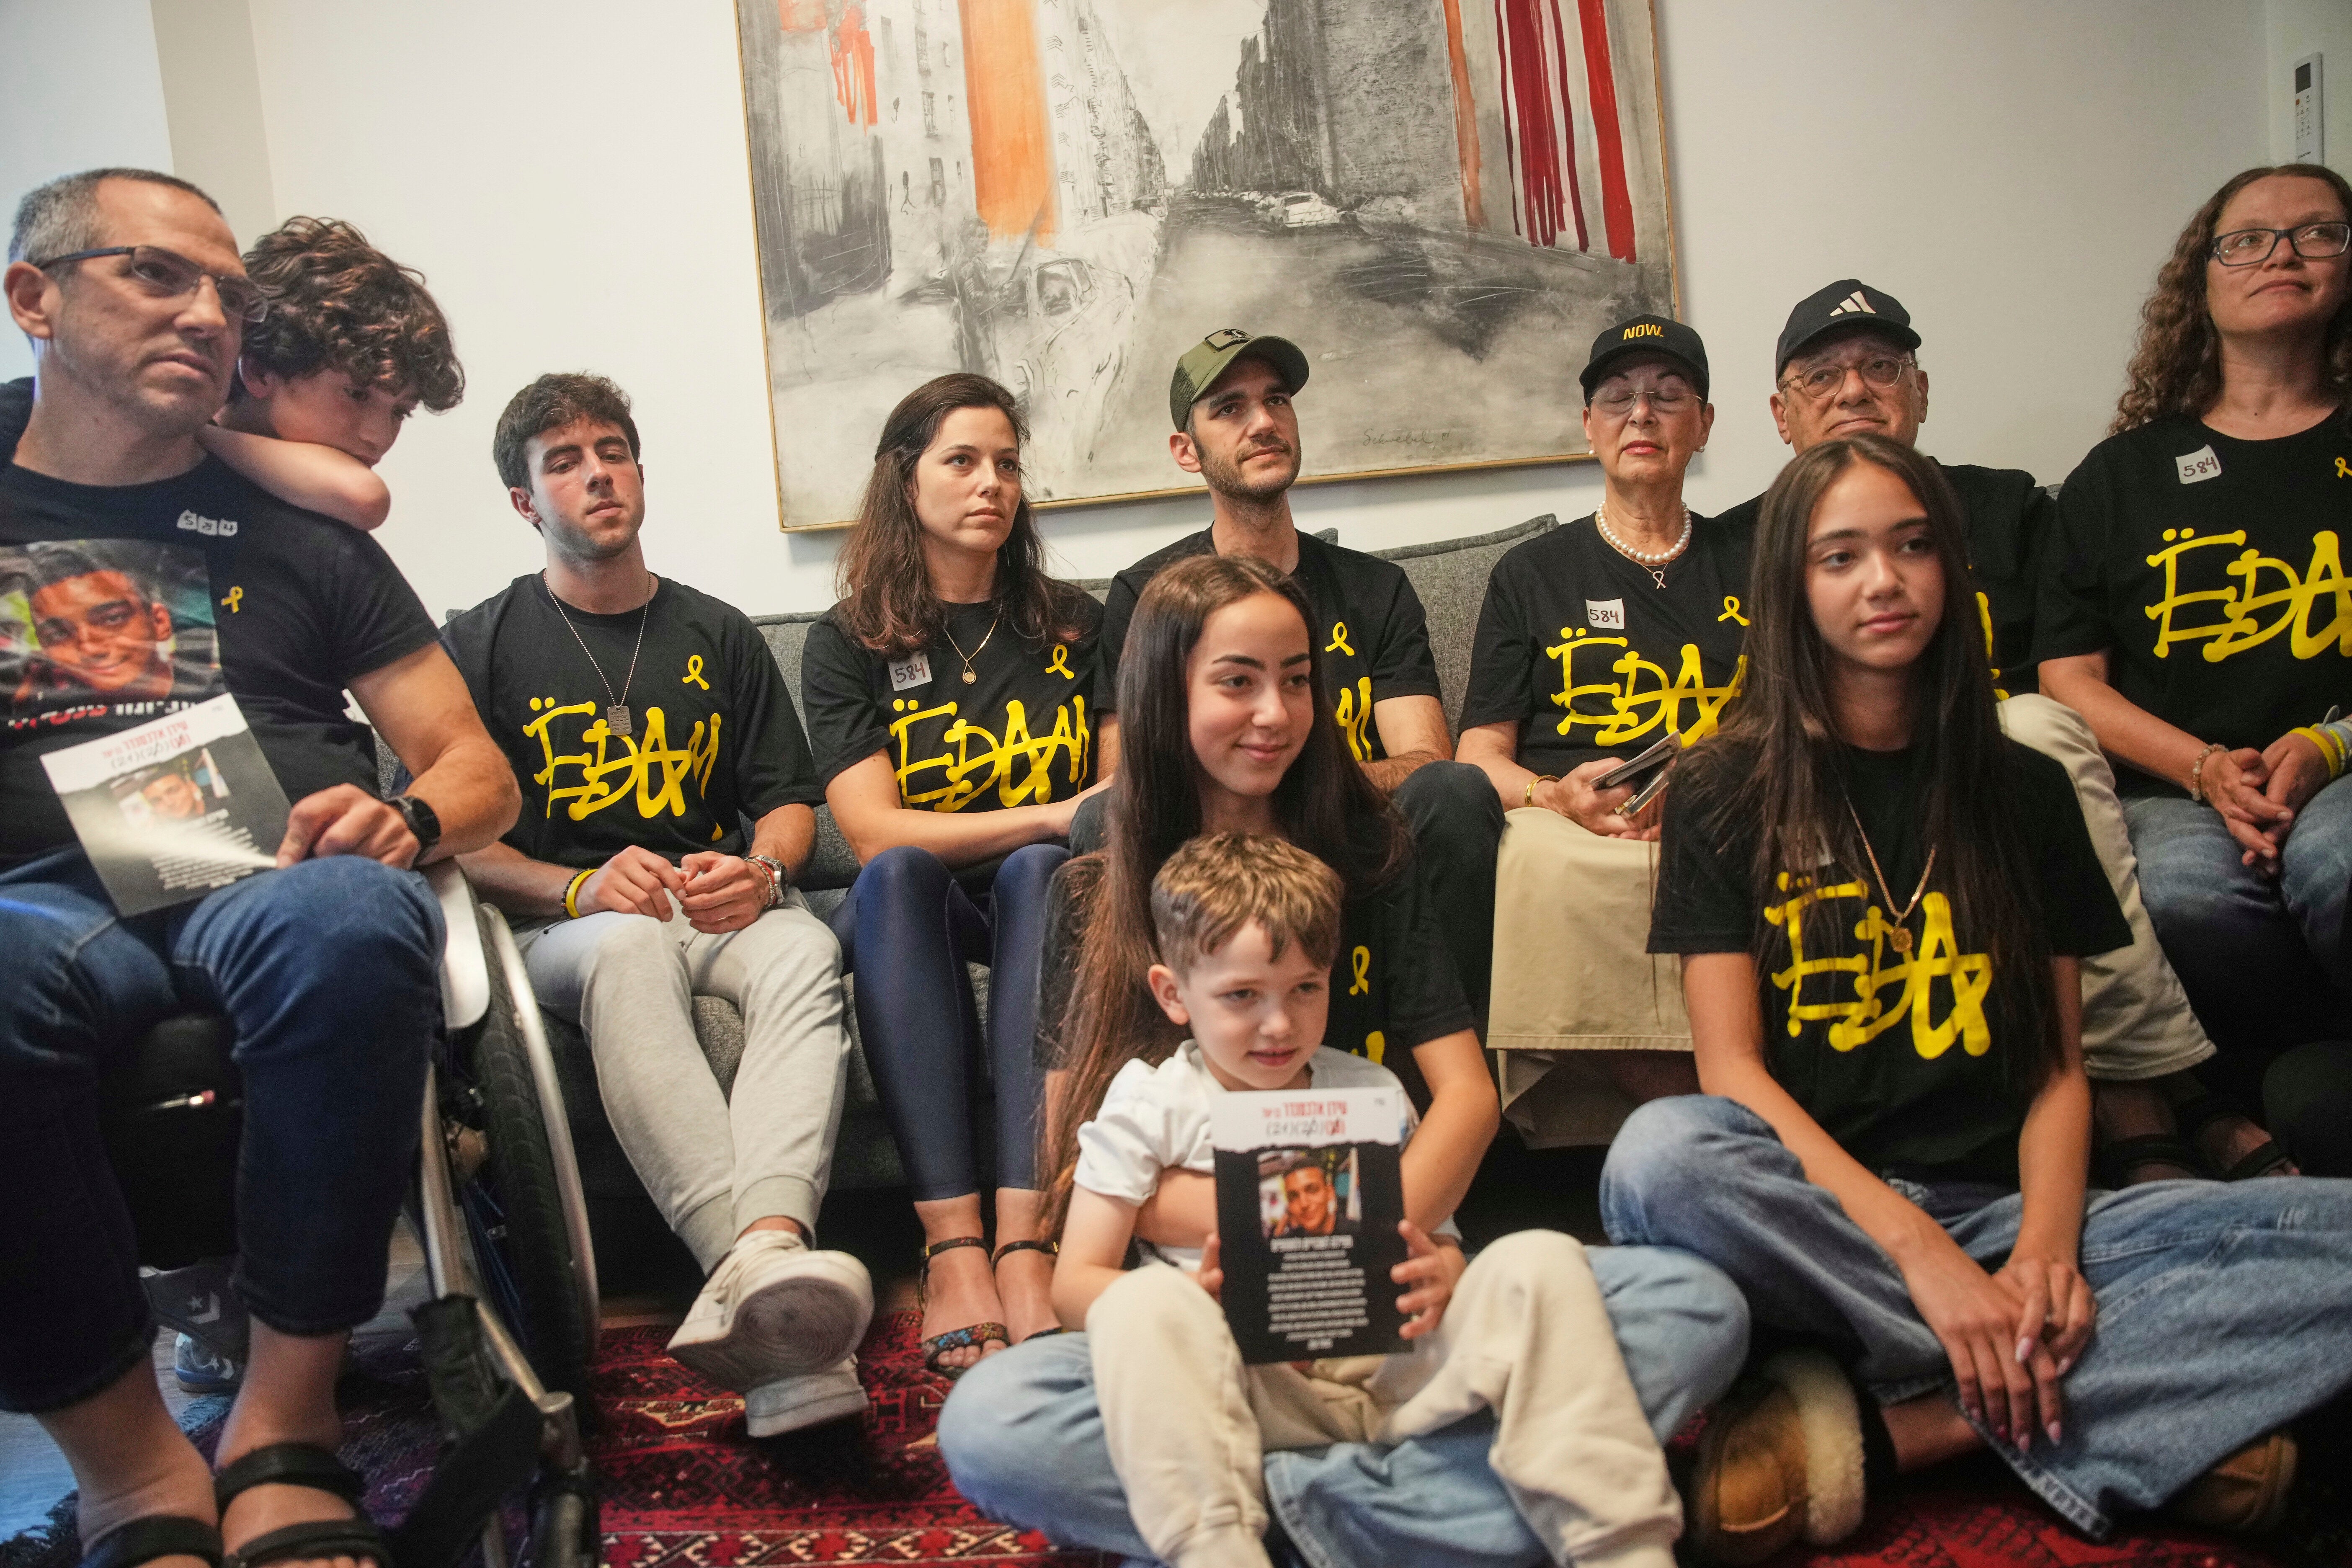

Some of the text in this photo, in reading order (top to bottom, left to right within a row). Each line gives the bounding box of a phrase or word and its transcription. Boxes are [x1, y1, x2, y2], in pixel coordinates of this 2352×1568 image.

[1623, 324, 1663, 340] NOW.
[2183, 457, 2218, 477] 584
[1589, 609, 1619, 624] 584
[895, 662, 926, 683] 584
